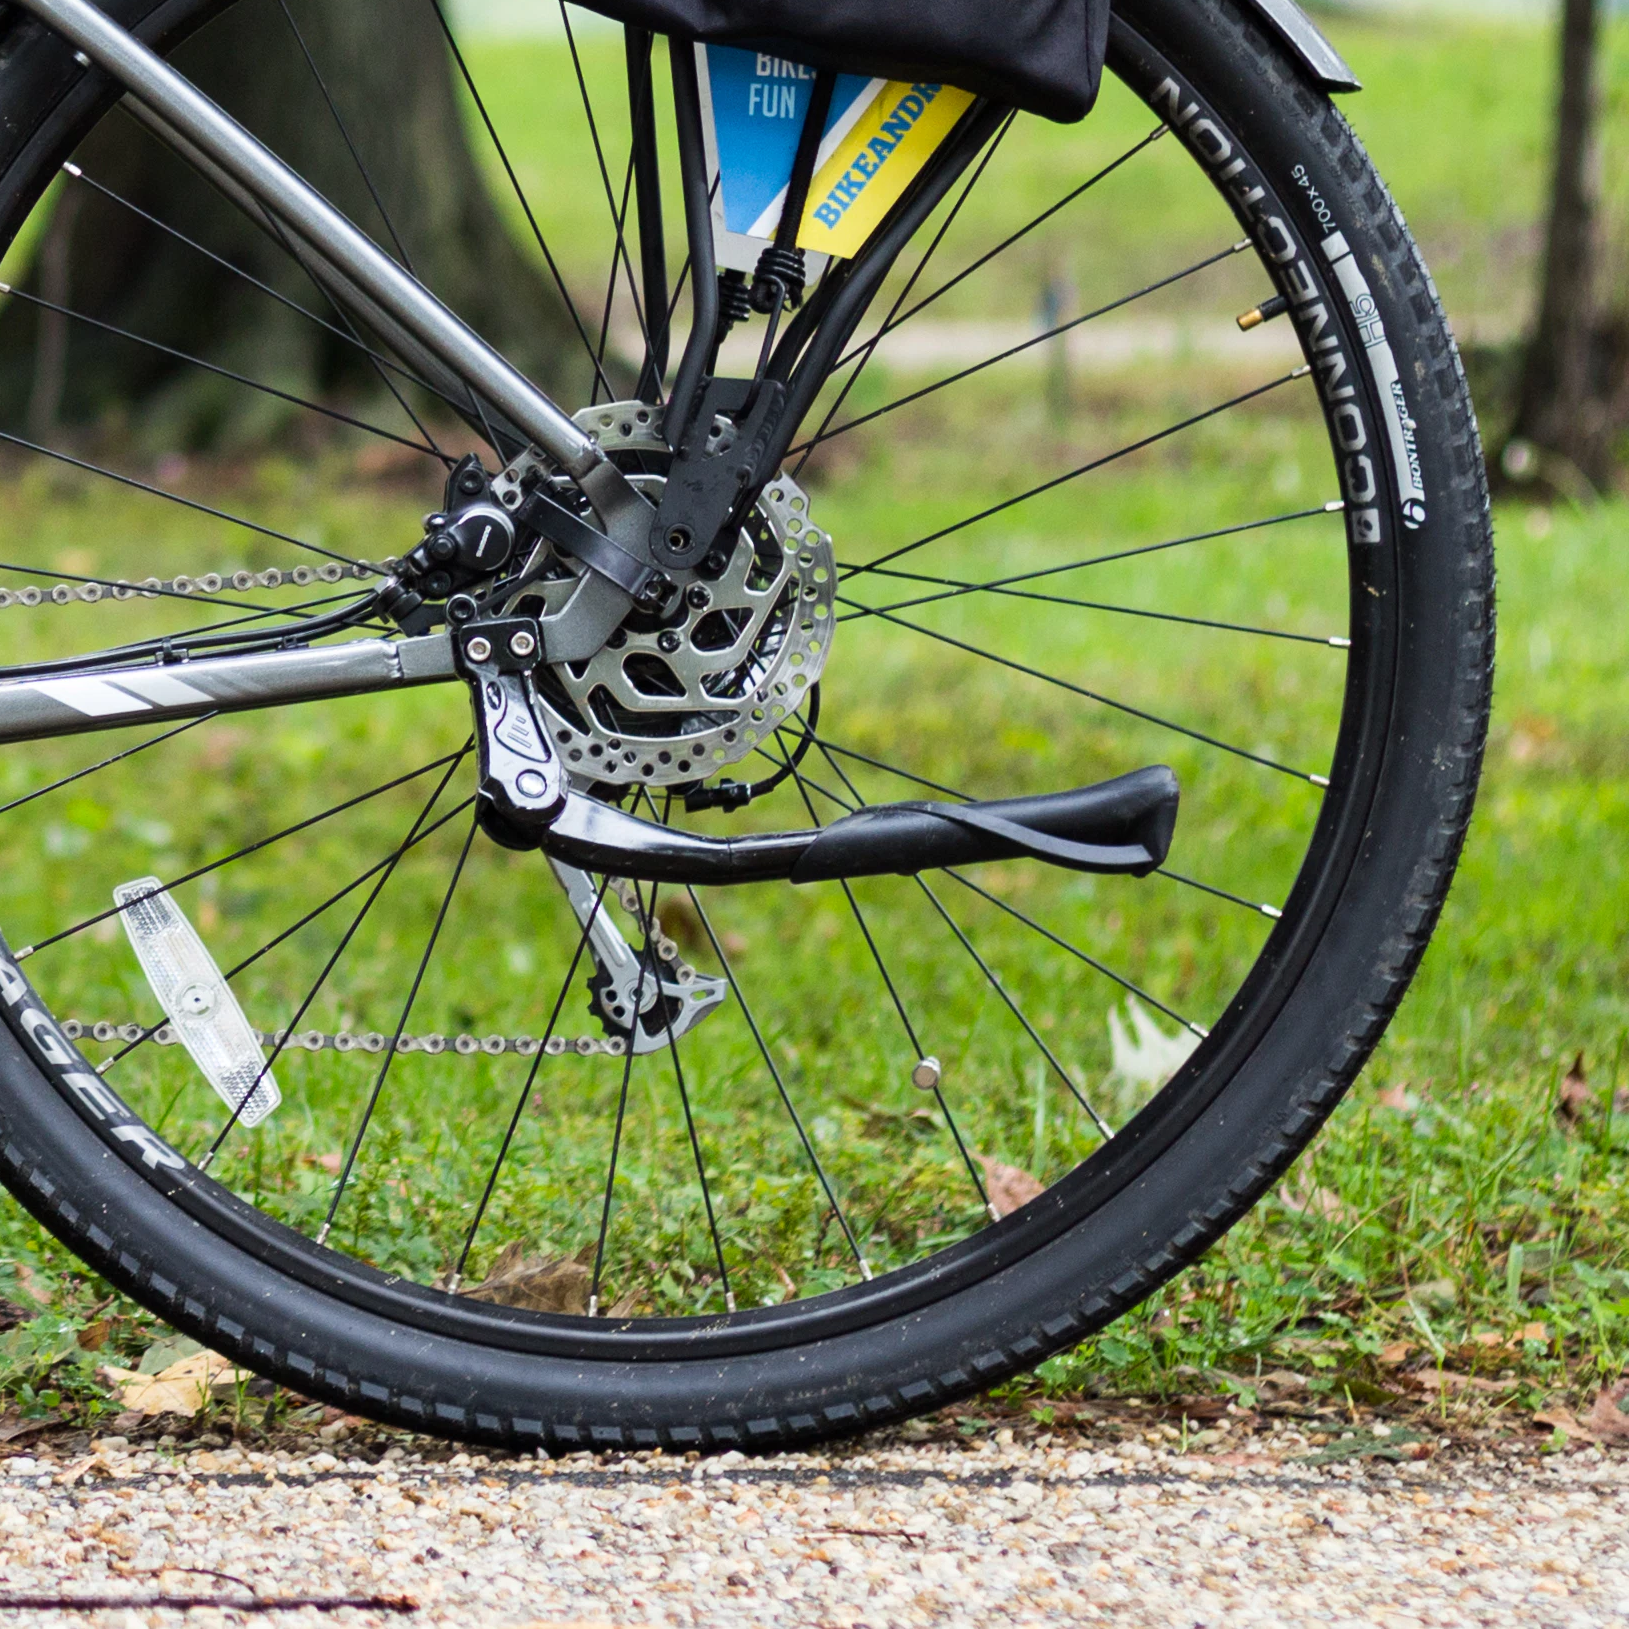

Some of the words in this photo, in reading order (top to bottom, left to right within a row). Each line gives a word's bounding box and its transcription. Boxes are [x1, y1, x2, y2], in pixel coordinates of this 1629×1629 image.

[748, 83, 796, 119] FUN
[1292, 165, 1336, 233] 700x45
[1151, 77, 1376, 505] CONNECTION
